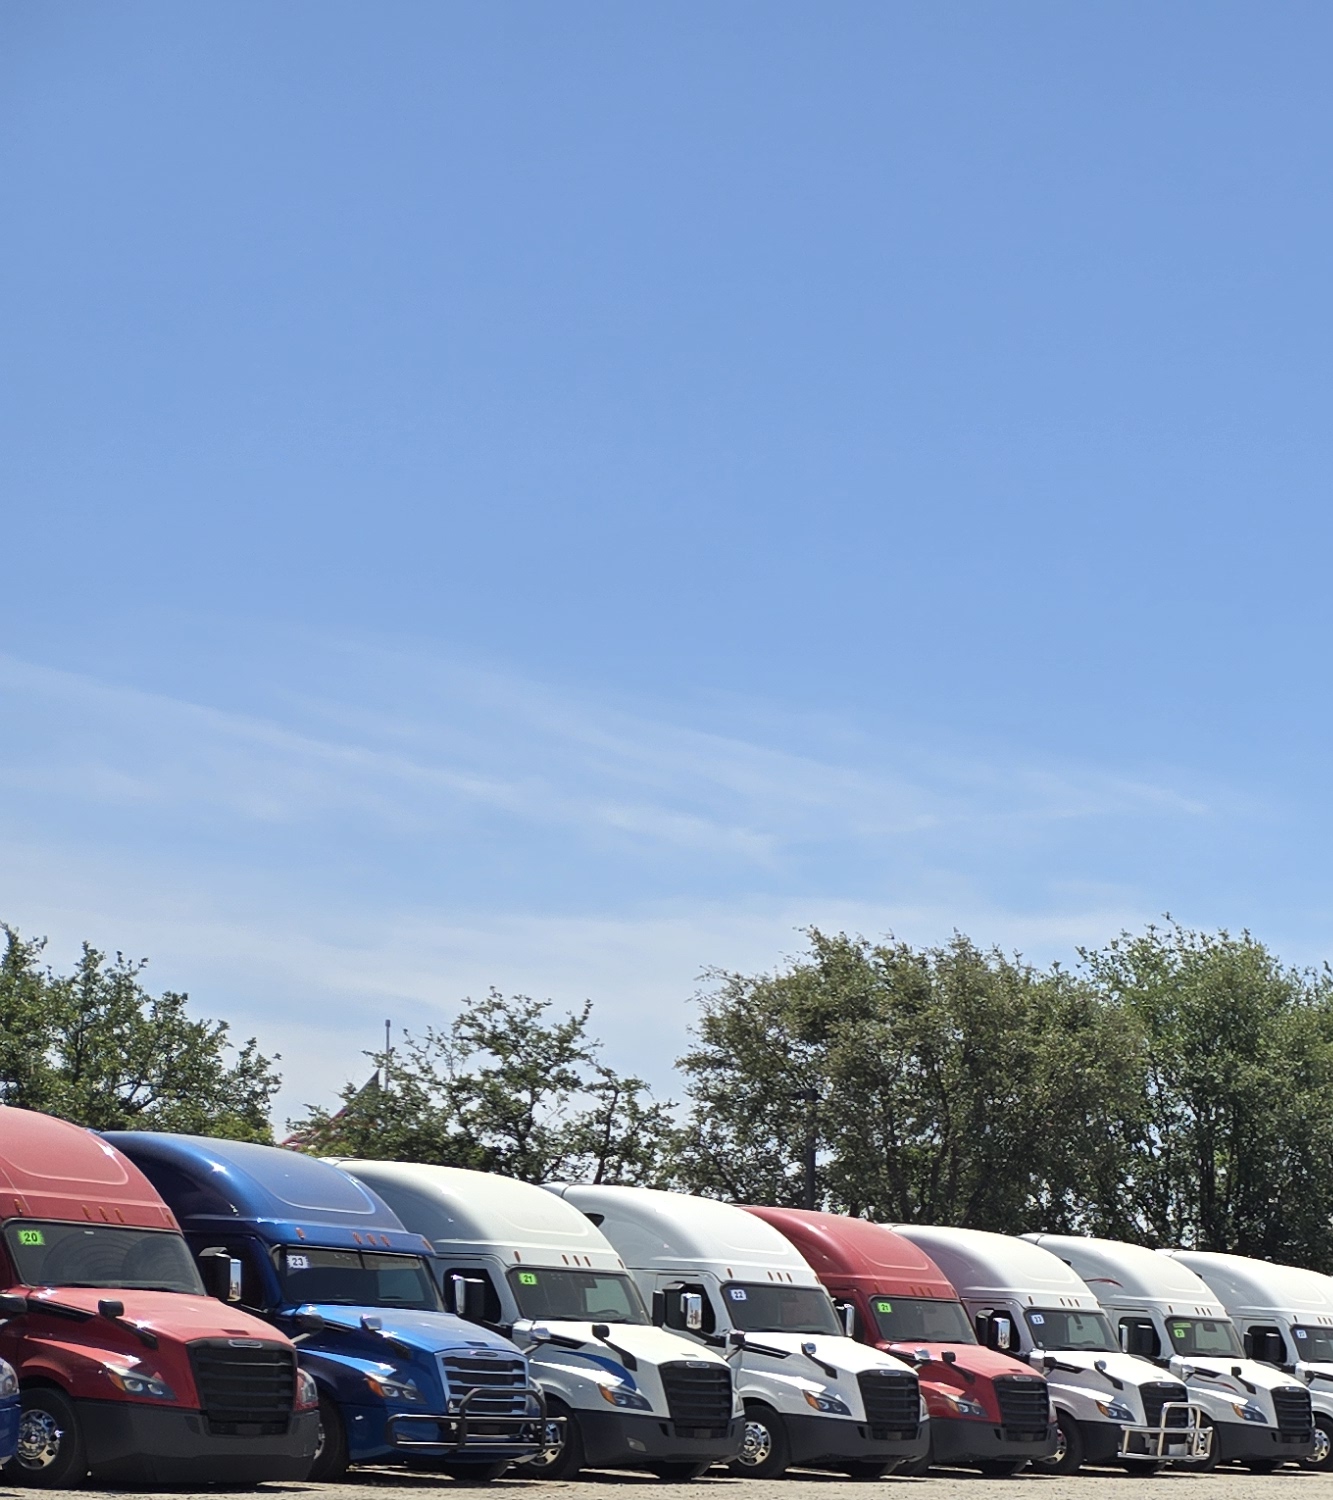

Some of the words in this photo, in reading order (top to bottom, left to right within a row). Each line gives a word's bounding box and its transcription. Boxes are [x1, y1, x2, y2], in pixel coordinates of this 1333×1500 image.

[23, 1232, 38, 1242] 20
[291, 1257, 304, 1267] 23
[523, 1274, 533, 1283] 21
